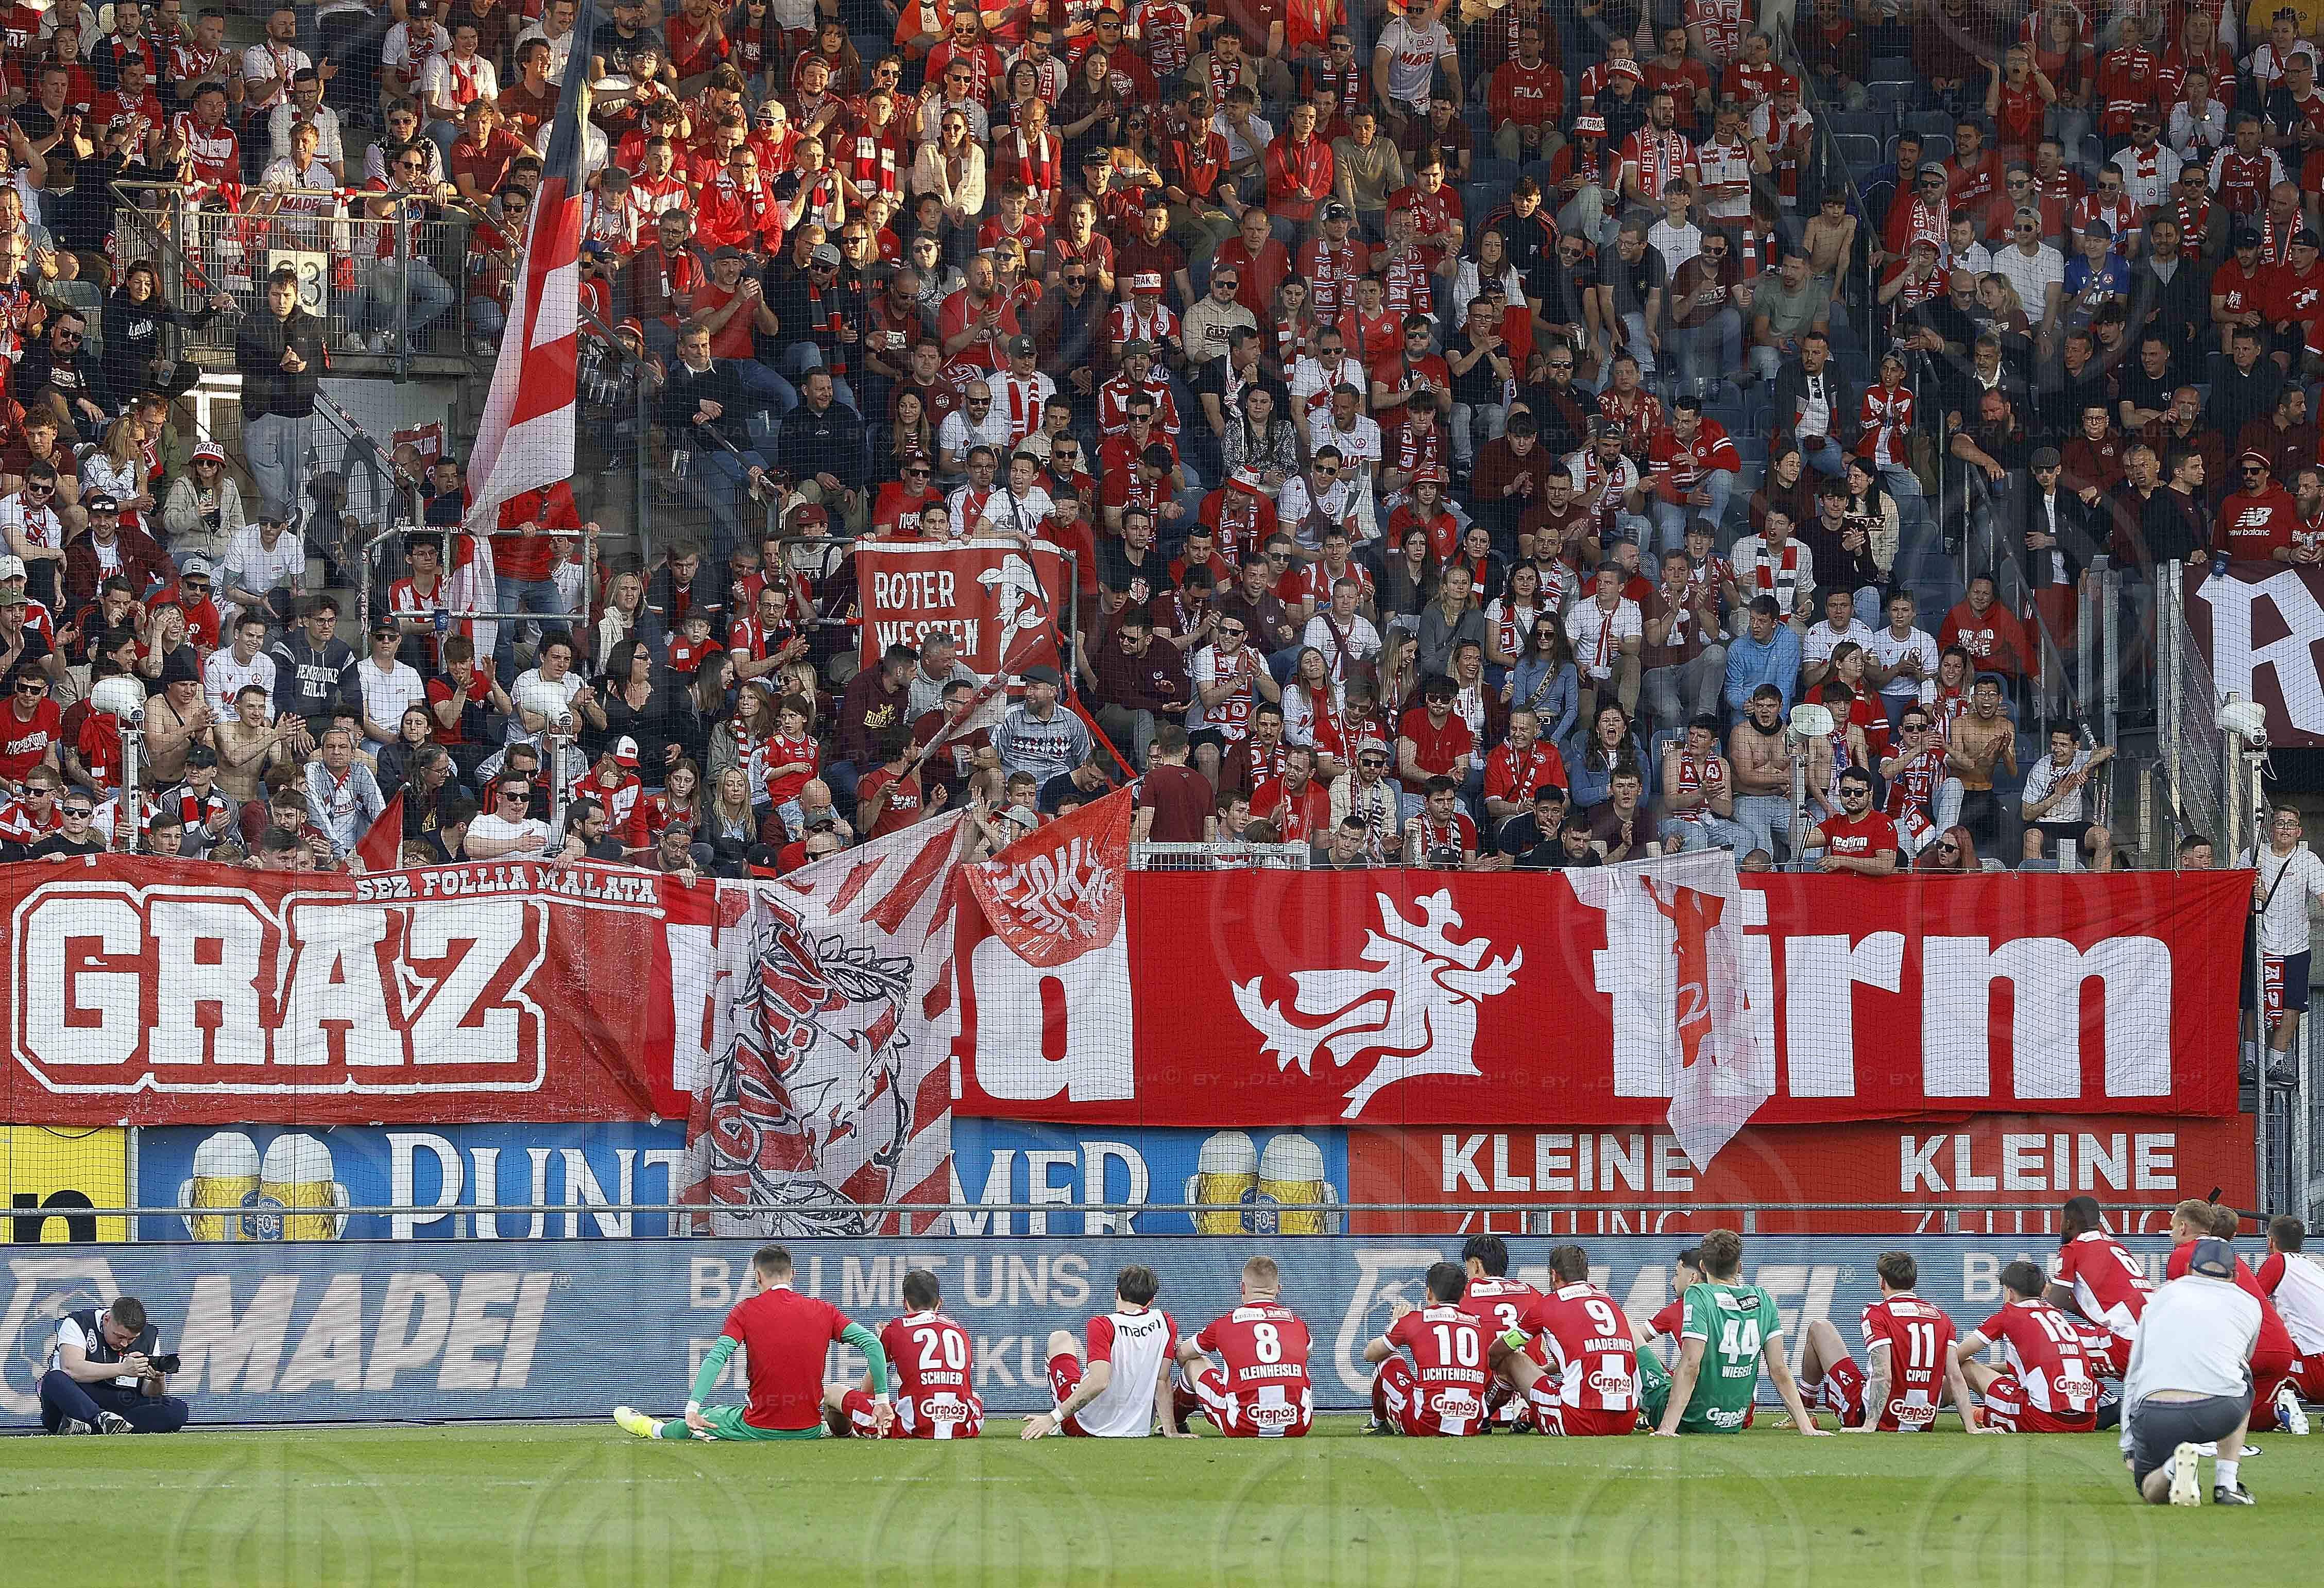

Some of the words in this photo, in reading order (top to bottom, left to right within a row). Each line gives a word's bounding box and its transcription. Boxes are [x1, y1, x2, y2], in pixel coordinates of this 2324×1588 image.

[1514, 86, 1544, 98] FILA
[2243, 528, 2270, 536] balanc
[874, 570, 955, 610] ROTER
[296, 664, 339, 684] PEMBROKE
[302, 680, 327, 699] HILL
[356, 877, 417, 900] SEZ.
[422, 866, 531, 899] FOLLIA
[536, 865, 657, 905] MALATA
[24, 895, 521, 1068] GRAZ
[1442, 1133, 1694, 1193] KLEINE
[1901, 1133, 2177, 1193] KLEINE
[965, 1255, 1089, 1307] UNS
[166, 1272, 554, 1392] MAPEI
[1584, 1299, 1617, 1337] 9
[2029, 1309, 2080, 1343] 18
[912, 1327, 967, 1371] 20
[1252, 1323, 1283, 1364] 8
[1433, 1322, 1480, 1368] 10
[1718, 1318, 1761, 1364] 44
[1906, 1322, 1936, 1369] 11
[920, 1370, 964, 1387] SCHRIEB
[1239, 1363, 1303, 1382] KLEINHEISLER
[1905, 1370, 1932, 1383] CIPOT
